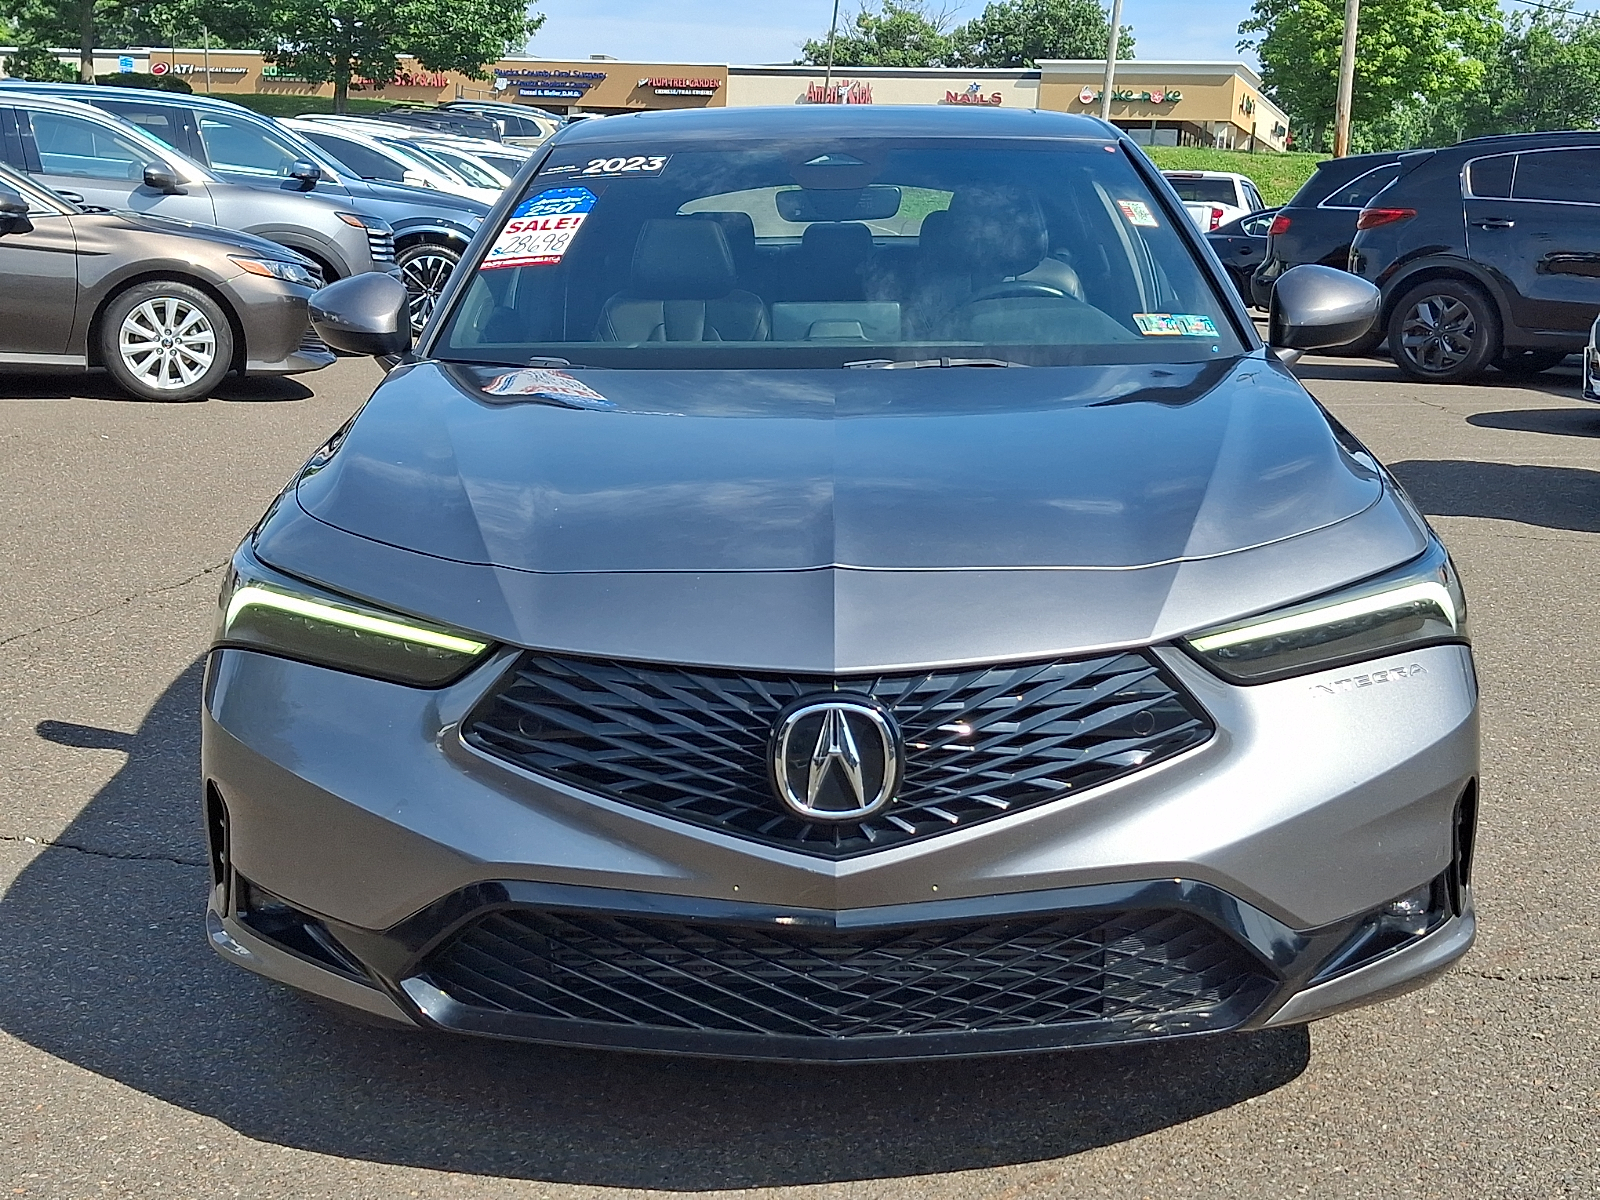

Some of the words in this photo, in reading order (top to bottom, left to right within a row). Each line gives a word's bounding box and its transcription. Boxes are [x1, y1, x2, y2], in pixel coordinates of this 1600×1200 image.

[170, 64, 195, 74] ATI
[521, 69, 550, 79] County
[648, 78, 668, 87] PLUM
[689, 78, 719, 88] GARDEN
[946, 91, 1002, 104] NAILS
[582, 155, 667, 175] 2023
[524, 203, 576, 216] 250
[506, 217, 581, 234] SALE!
[1309, 663, 1428, 698] NTEGRA
